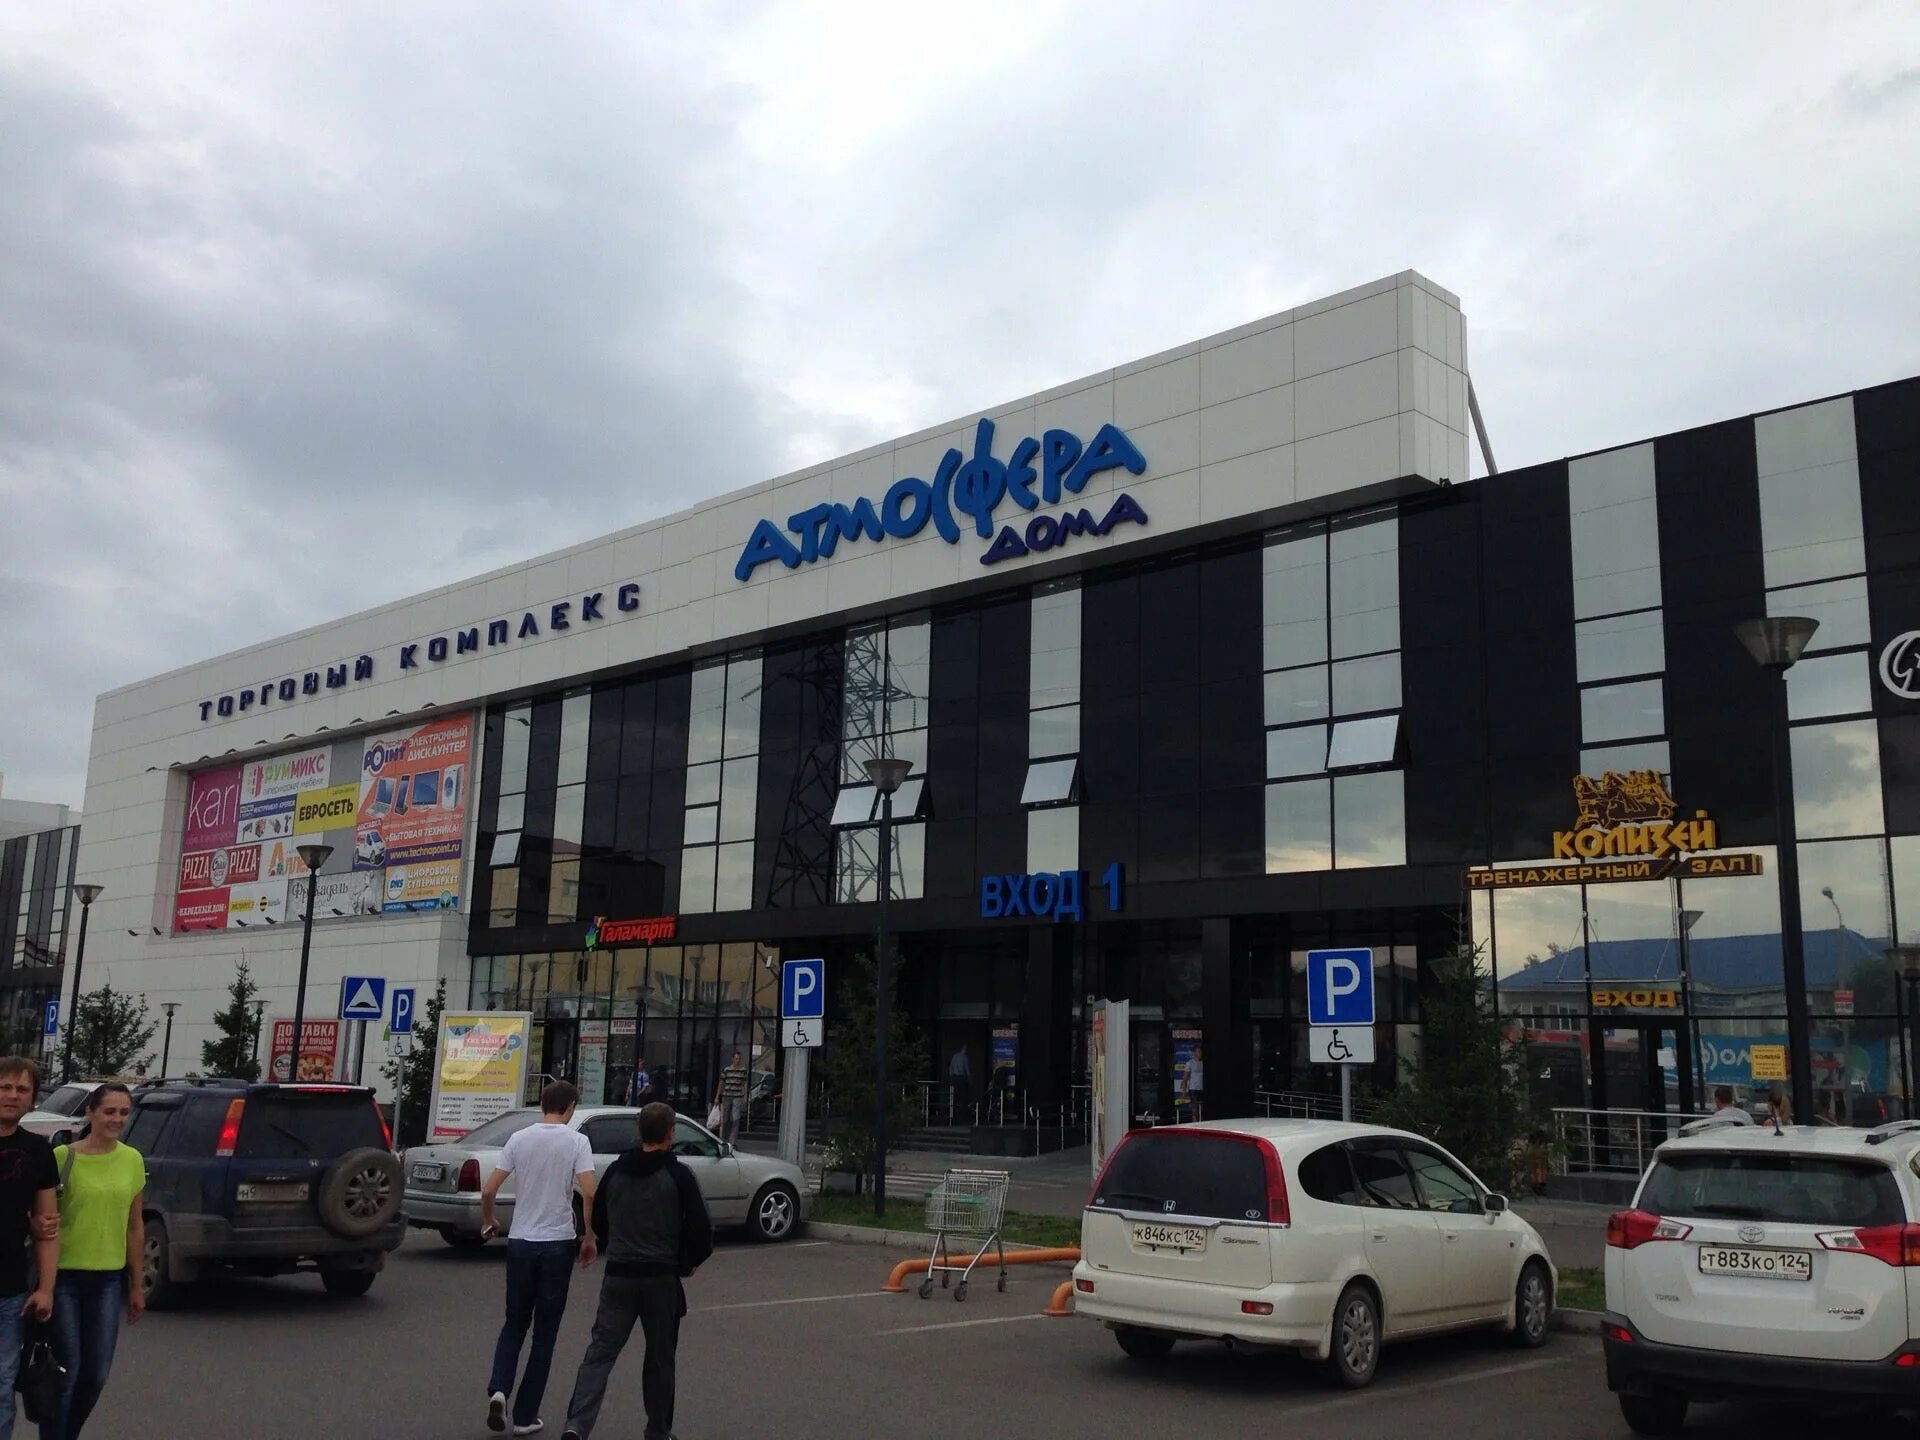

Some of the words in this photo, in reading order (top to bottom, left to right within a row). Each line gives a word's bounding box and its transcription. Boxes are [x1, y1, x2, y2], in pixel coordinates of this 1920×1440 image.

[734, 417, 1147, 582] АТМОСФЕРА
[979, 493, 1148, 565] ДОМА
[199, 655, 373, 721] ТОРГОВЫЙ
[400, 583, 640, 669] КОМПЛЕКС
[408, 725, 469, 748] ЭЛЕКТРОННЫЙ
[408, 740, 466, 761] ДИСКАУНТЕР
[187, 770, 240, 831] kari
[299, 798, 354, 822] ЕВРОСЕТЬ
[1553, 810, 1717, 859] КОЛИЗЕЙ
[183, 856, 210, 881] PIZZA
[229, 849, 257, 874] PIZZA
[390, 843, 460, 860] www.technopoint.ru
[390, 879, 403, 889] DNS
[1466, 860, 1651, 886] ТРЕНАЖЕРНЫЙ
[1691, 857, 1746, 874] ЗАЛ
[981, 870, 1086, 923] ВХОД
[1103, 861, 1126, 911] 1
[600, 917, 676, 946] Галамарт
[793, 967, 816, 1011] P
[1326, 958, 1360, 1016] P
[1592, 990, 1677, 1008] ВХОД
[48, 1005, 57, 1031] P
[396, 994, 409, 1029] P
[277, 1024, 335, 1037] ДОТАВКА
[1136, 1226, 1182, 1243] К846КС
[1183, 1229, 1201, 1241] 124
[1706, 1251, 1775, 1271] Т883КО
[1778, 1254, 1806, 1268] 124
